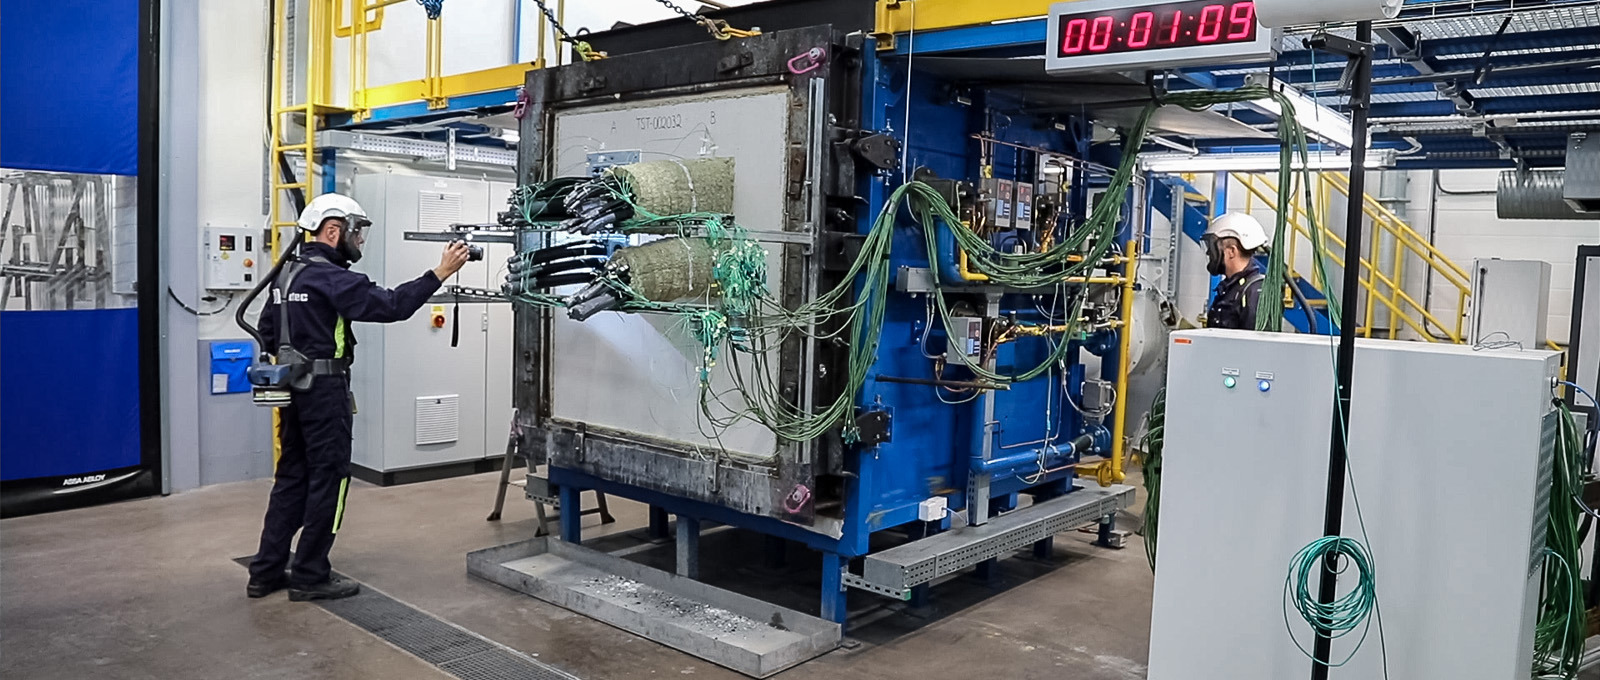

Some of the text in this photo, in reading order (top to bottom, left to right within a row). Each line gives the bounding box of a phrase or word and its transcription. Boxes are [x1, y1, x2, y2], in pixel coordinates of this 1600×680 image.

[1063, 2, 1255, 53] 00:01:09
[636, 114, 682, 130] TST-002032
[710, 110, 717, 125] B
[610, 120, 617, 134] A
